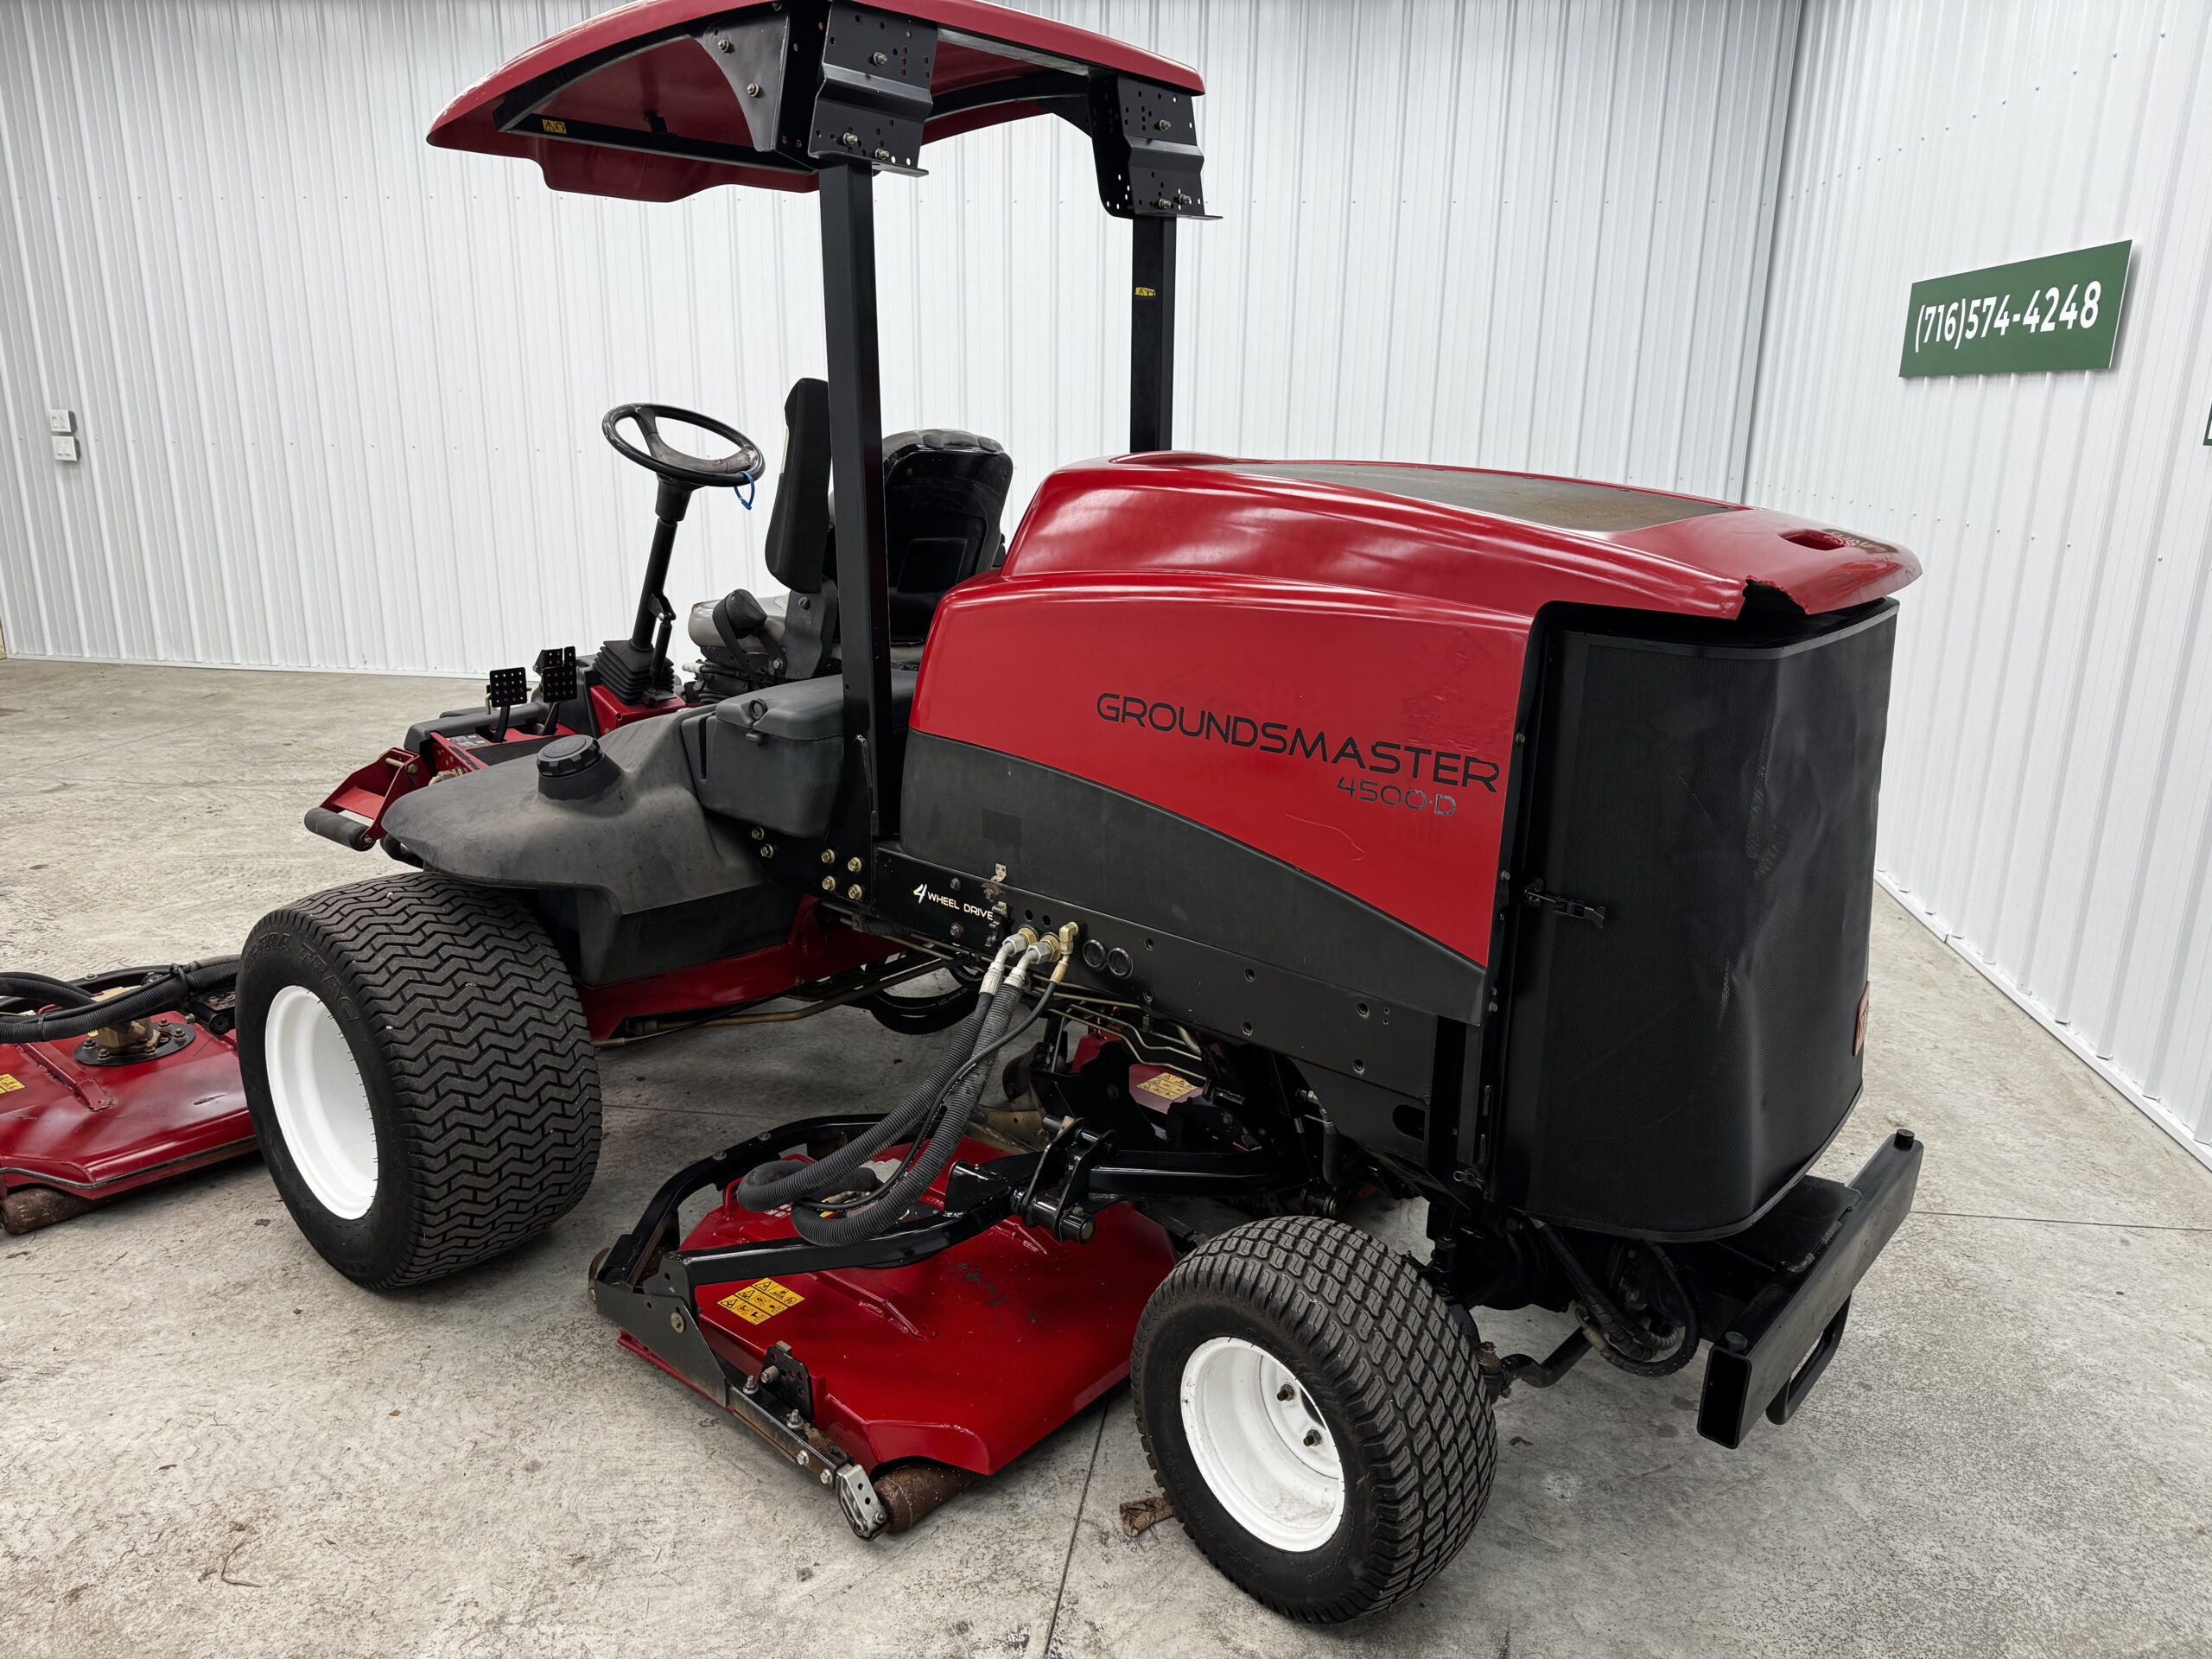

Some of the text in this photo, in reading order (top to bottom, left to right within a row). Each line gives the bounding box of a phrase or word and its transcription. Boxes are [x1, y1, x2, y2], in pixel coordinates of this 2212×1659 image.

[1915, 280, 2101, 353] (716)574-4248
[1096, 692, 1500, 792] GROUNDSMASTER
[913, 883, 994, 921] 4 WHEEL DRIVE
